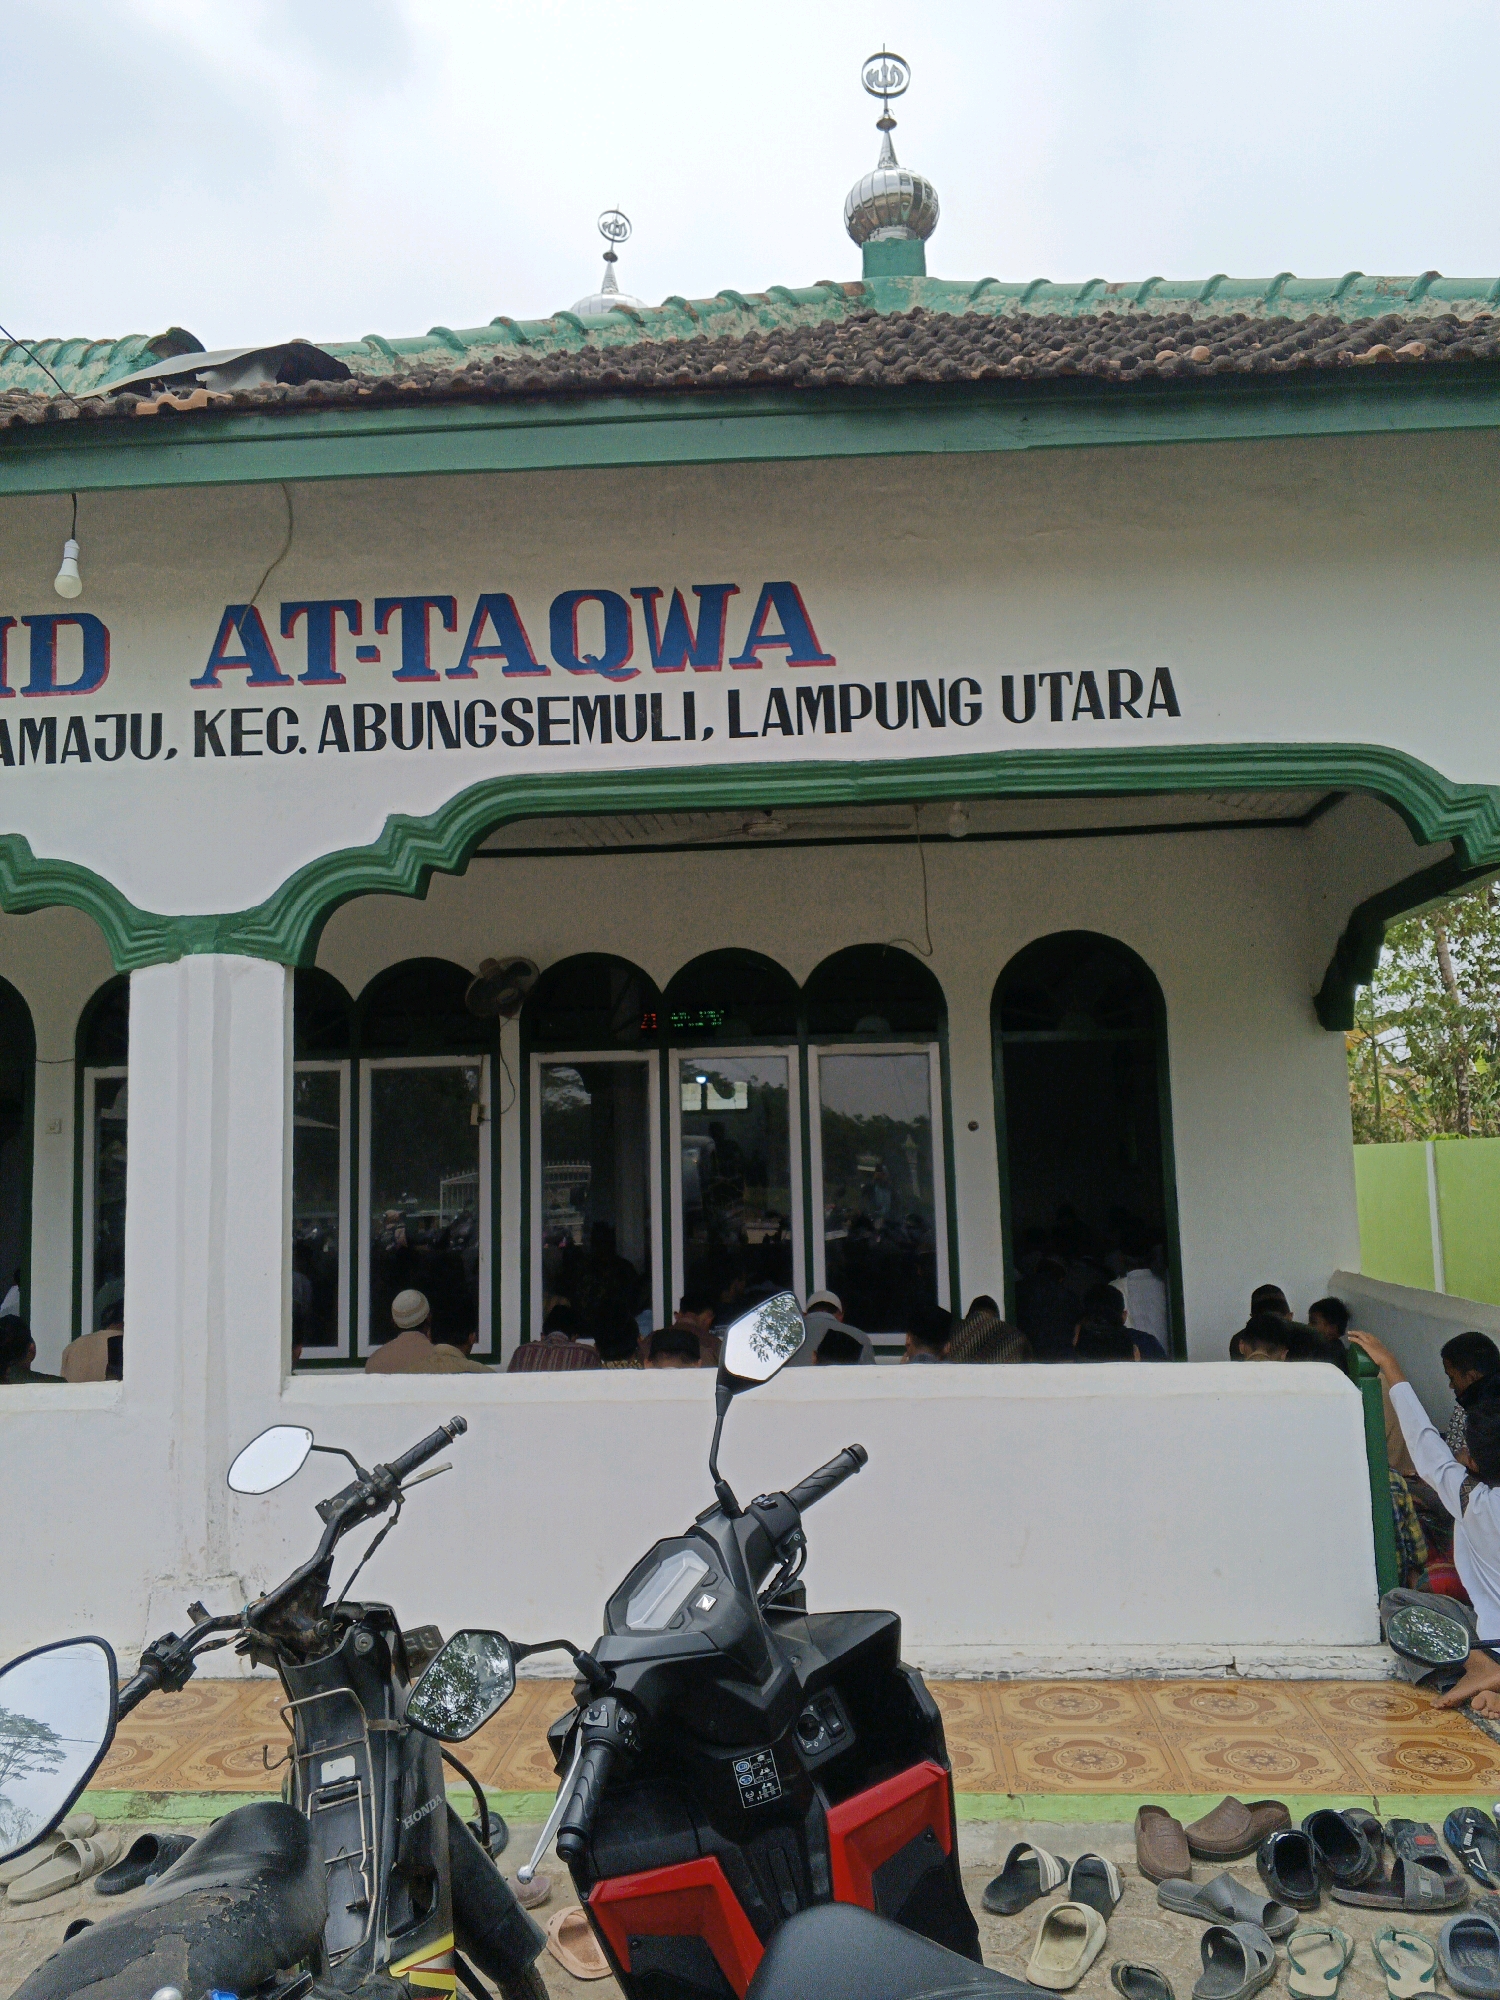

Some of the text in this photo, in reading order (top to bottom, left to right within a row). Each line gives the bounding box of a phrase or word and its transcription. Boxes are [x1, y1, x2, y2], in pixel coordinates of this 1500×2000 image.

[190, 581, 837, 688] AT-TAQWA
[727, 677, 983, 739] LAMPUNG
[1001, 666, 1182, 724] UTARA
[402, 1794, 443, 1830] HONDA
